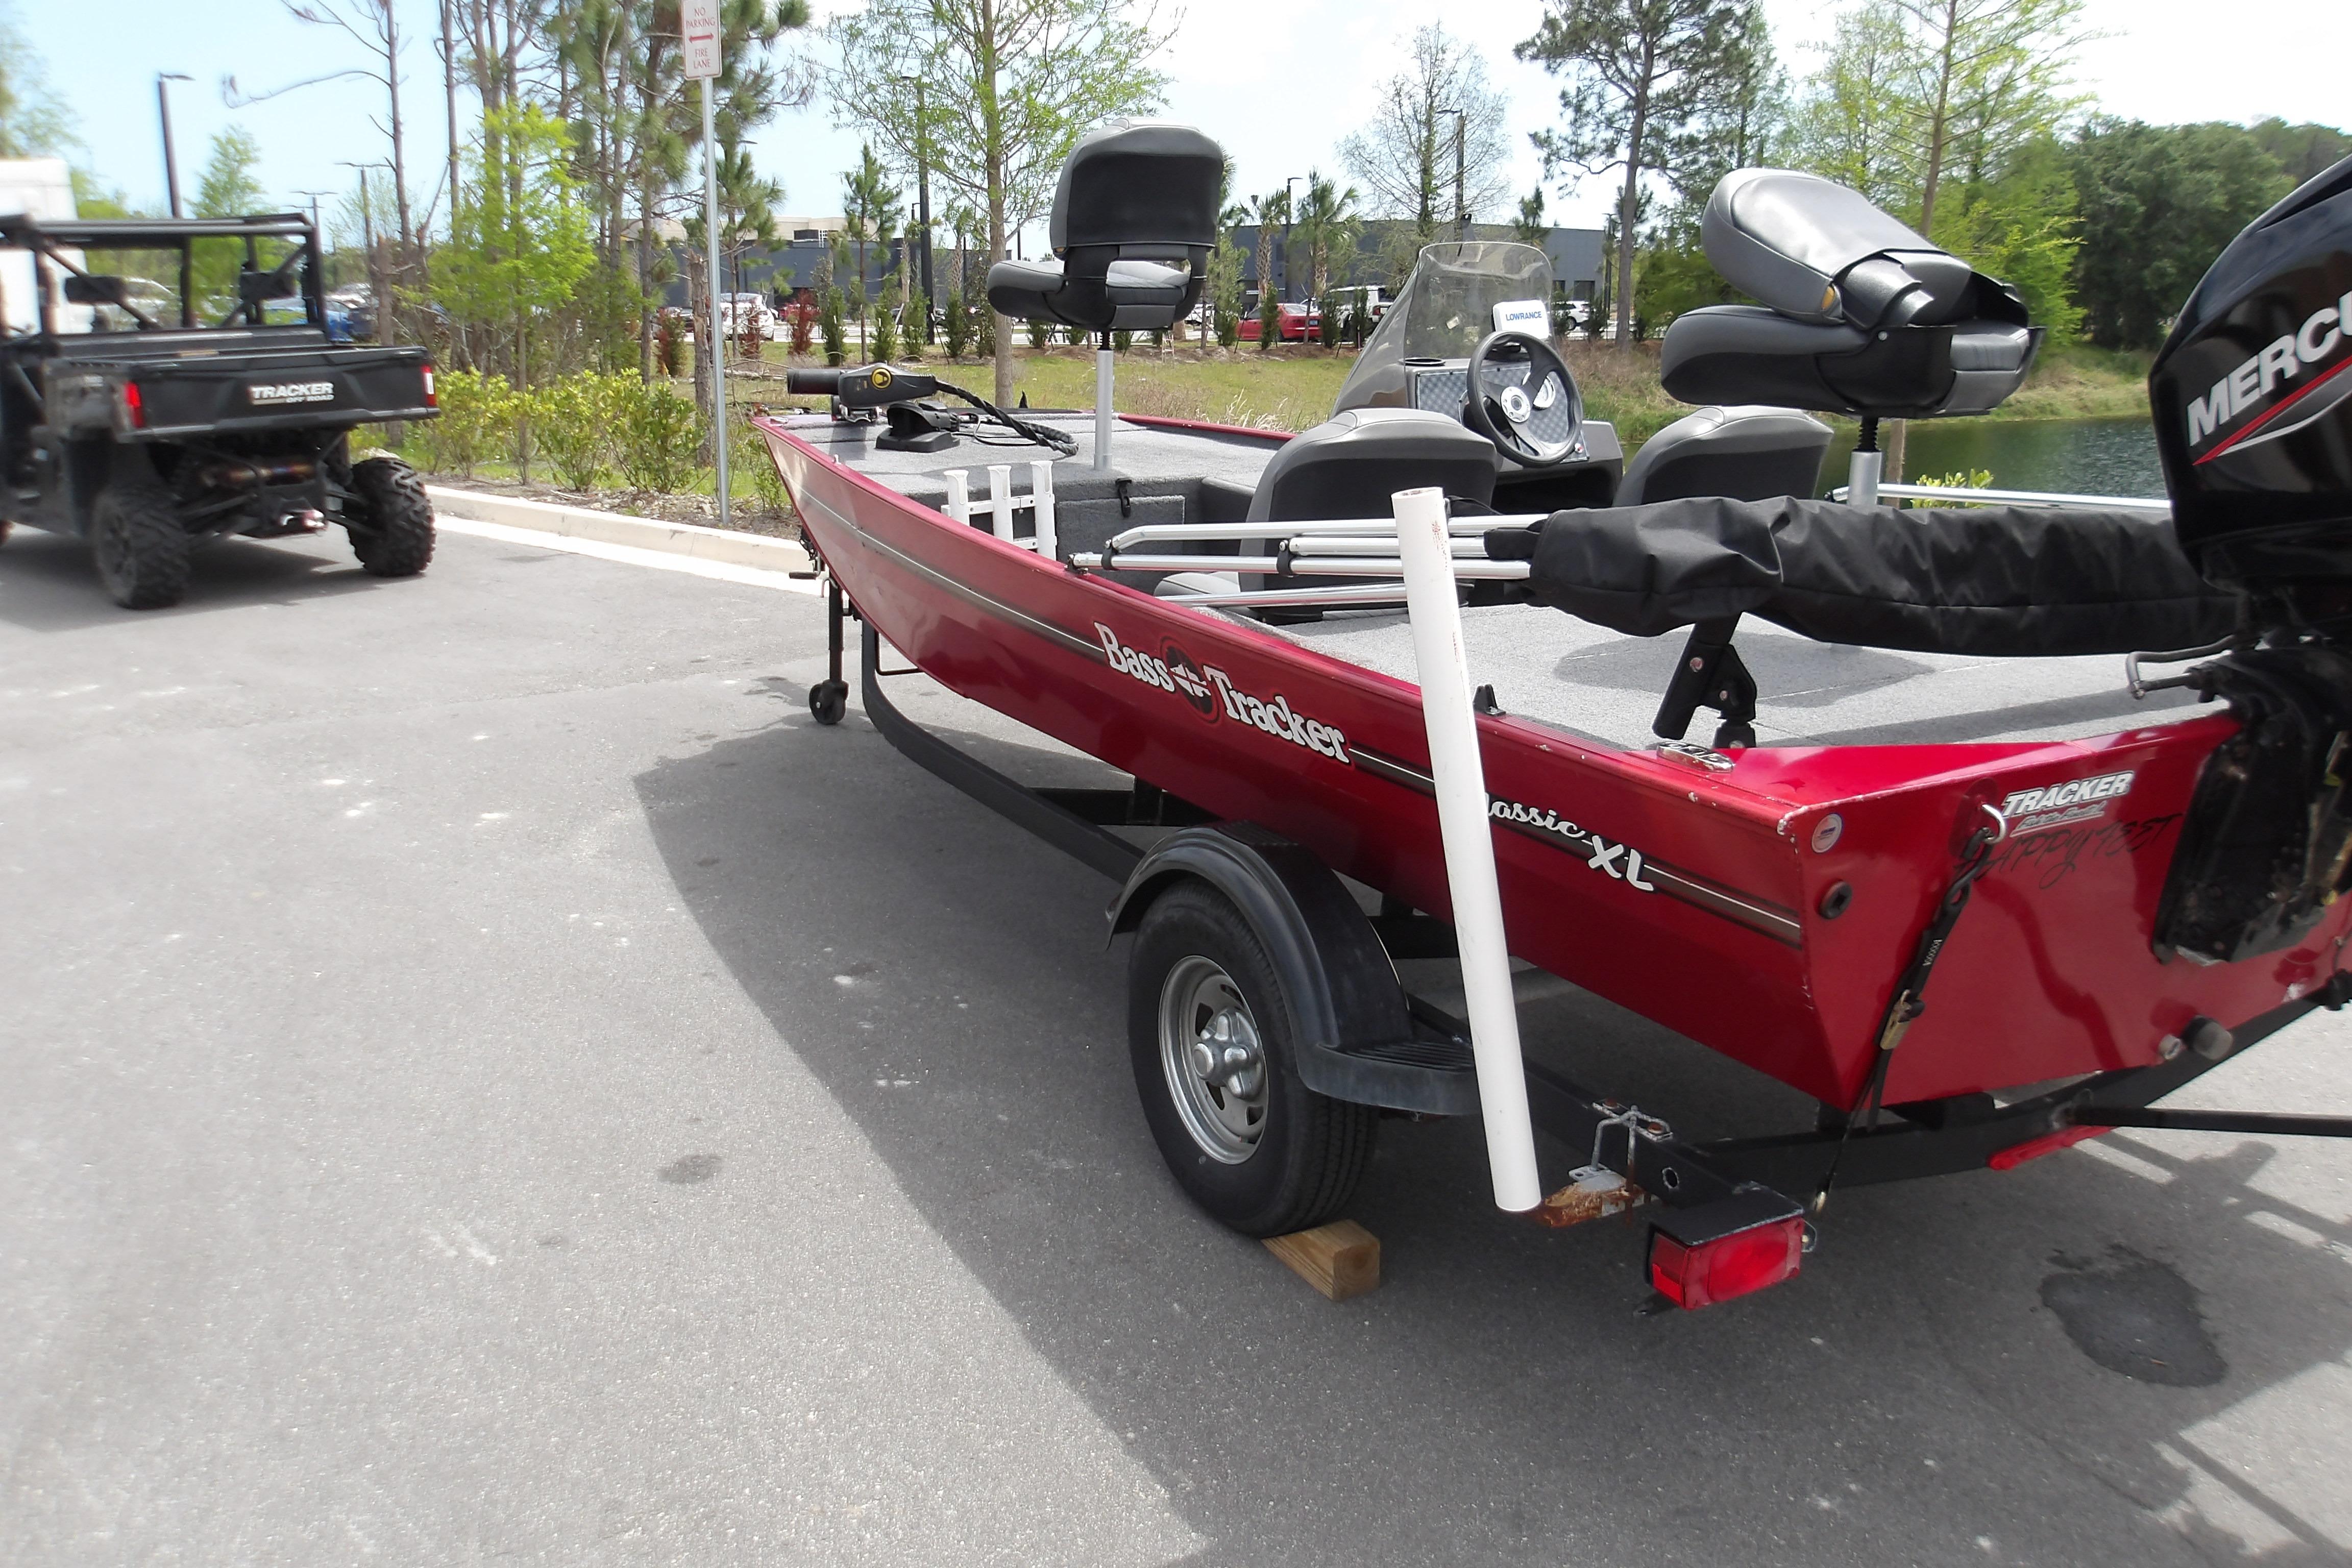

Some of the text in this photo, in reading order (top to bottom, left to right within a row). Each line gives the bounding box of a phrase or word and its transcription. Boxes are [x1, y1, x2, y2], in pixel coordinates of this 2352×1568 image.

[695, 8, 705, 16] NO
[687, 18, 715, 29] PARKING
[695, 48, 708, 57] FIRE
[694, 59, 711, 69] LANE
[1506, 311, 1542, 321] LOWRANCE
[252, 383, 334, 399] TRACKER
[1094, 621, 1351, 763] Bass Tracker
[2002, 771, 2134, 818] TRACKER
[1485, 791, 1655, 892] lassic XL
